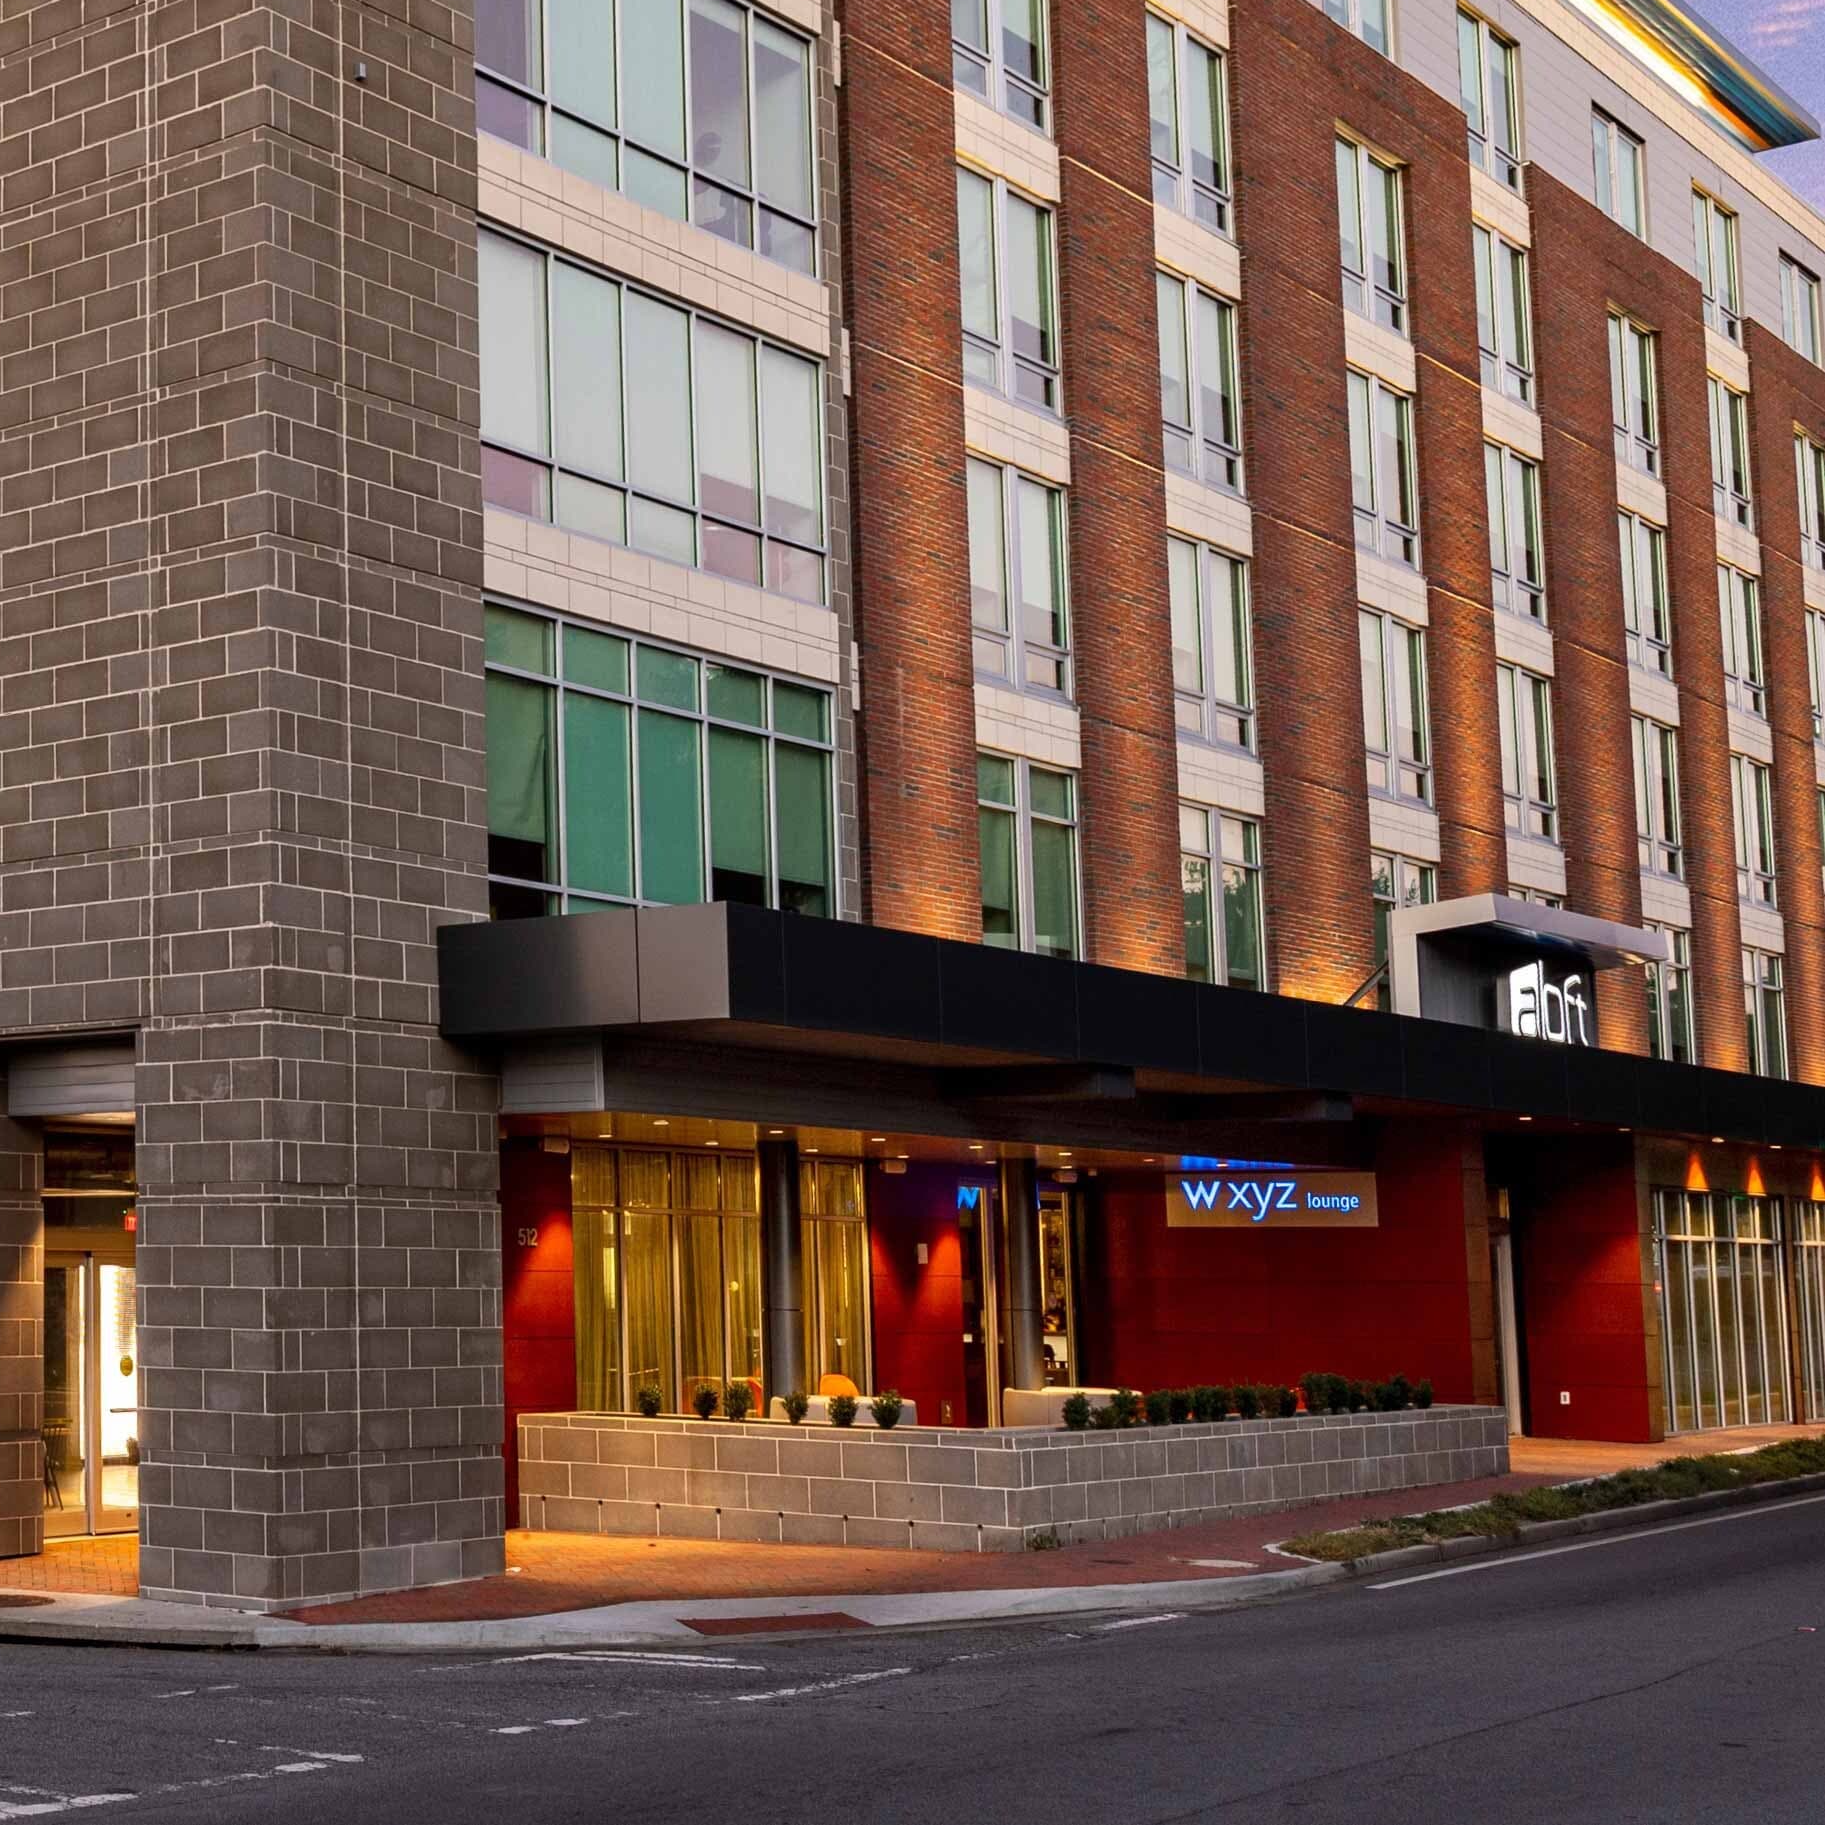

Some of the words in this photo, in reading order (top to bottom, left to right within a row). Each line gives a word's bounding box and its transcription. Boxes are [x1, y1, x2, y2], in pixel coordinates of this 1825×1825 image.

[1509, 959, 1589, 1047] aloft
[1307, 1192, 1360, 1212] lounge
[517, 1227, 538, 1246] 512
